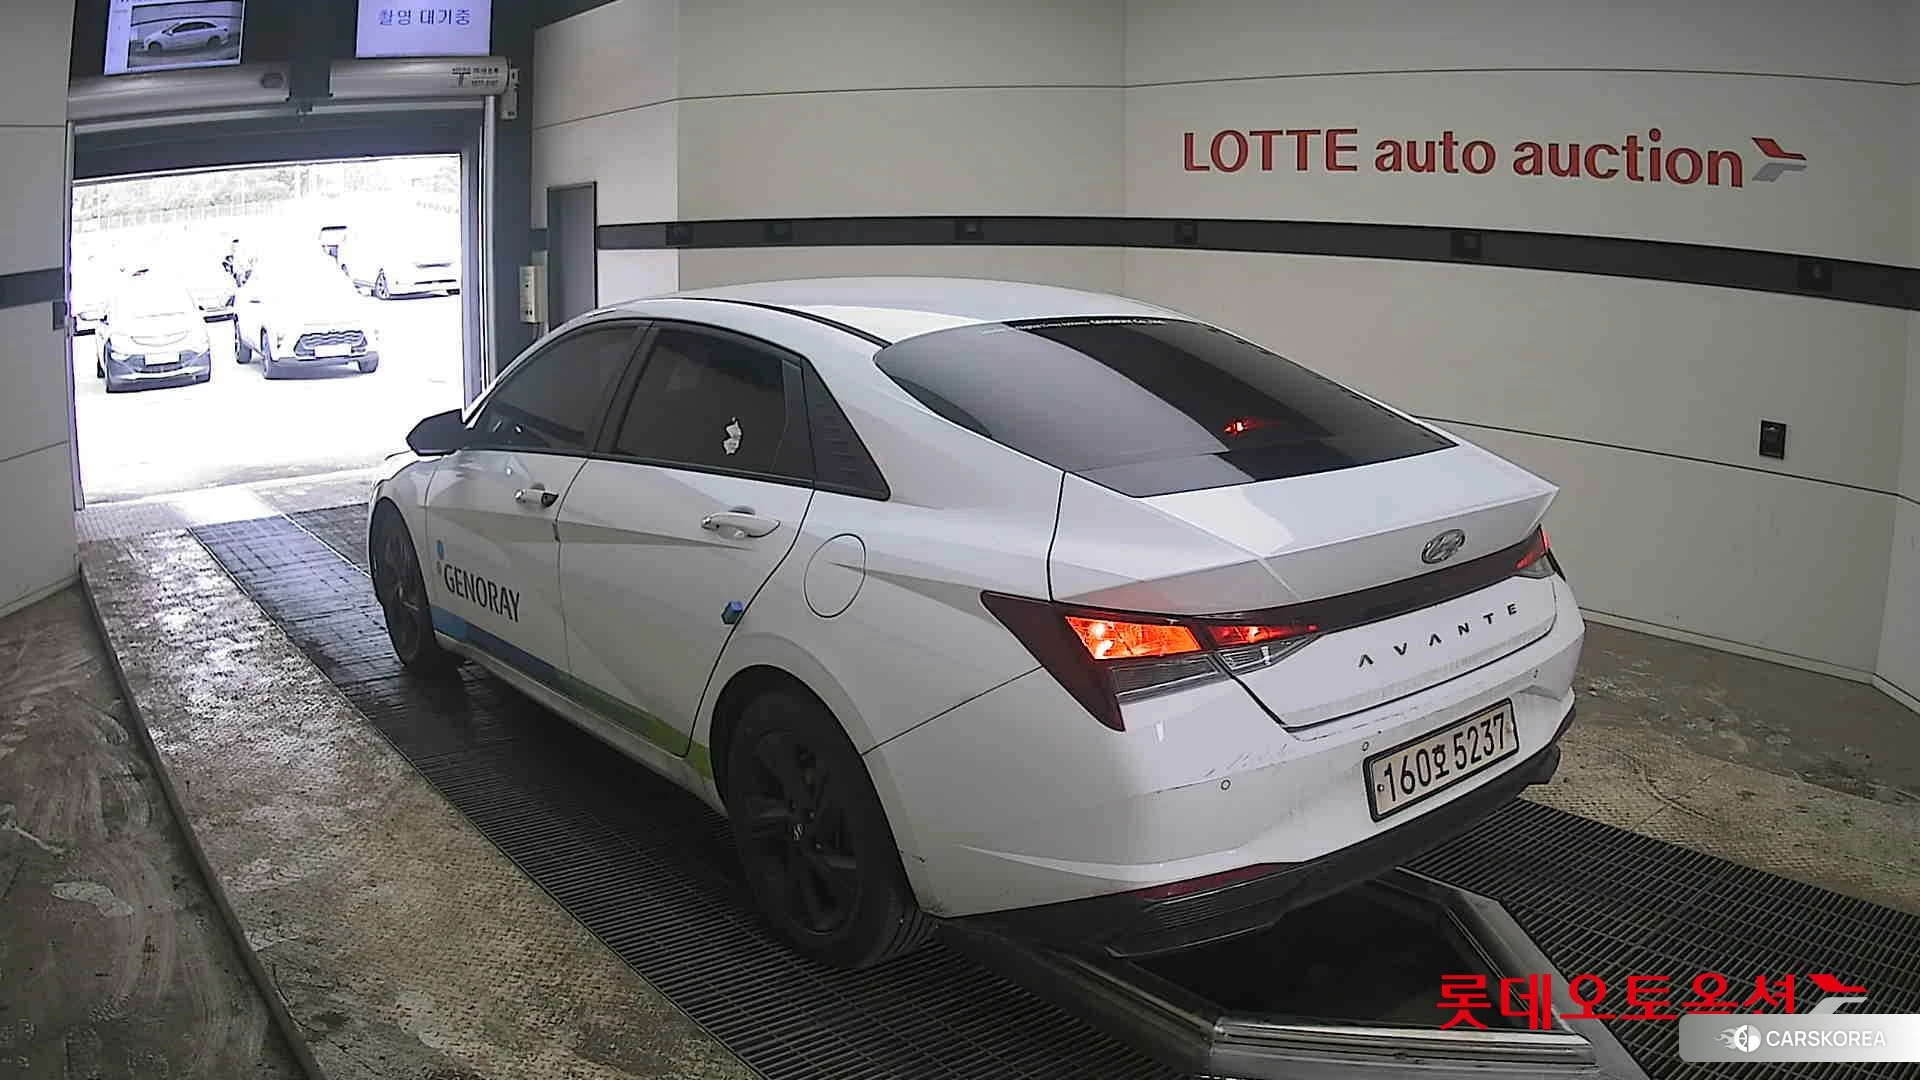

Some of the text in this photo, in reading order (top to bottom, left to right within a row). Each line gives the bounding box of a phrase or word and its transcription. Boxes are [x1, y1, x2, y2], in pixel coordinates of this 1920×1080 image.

[420, 9, 471, 25] 대기중
[1184, 128, 1743, 188] LOTTE auto auction
[444, 564, 519, 622] GENORAY
[1359, 603, 1517, 668] AVANTE
